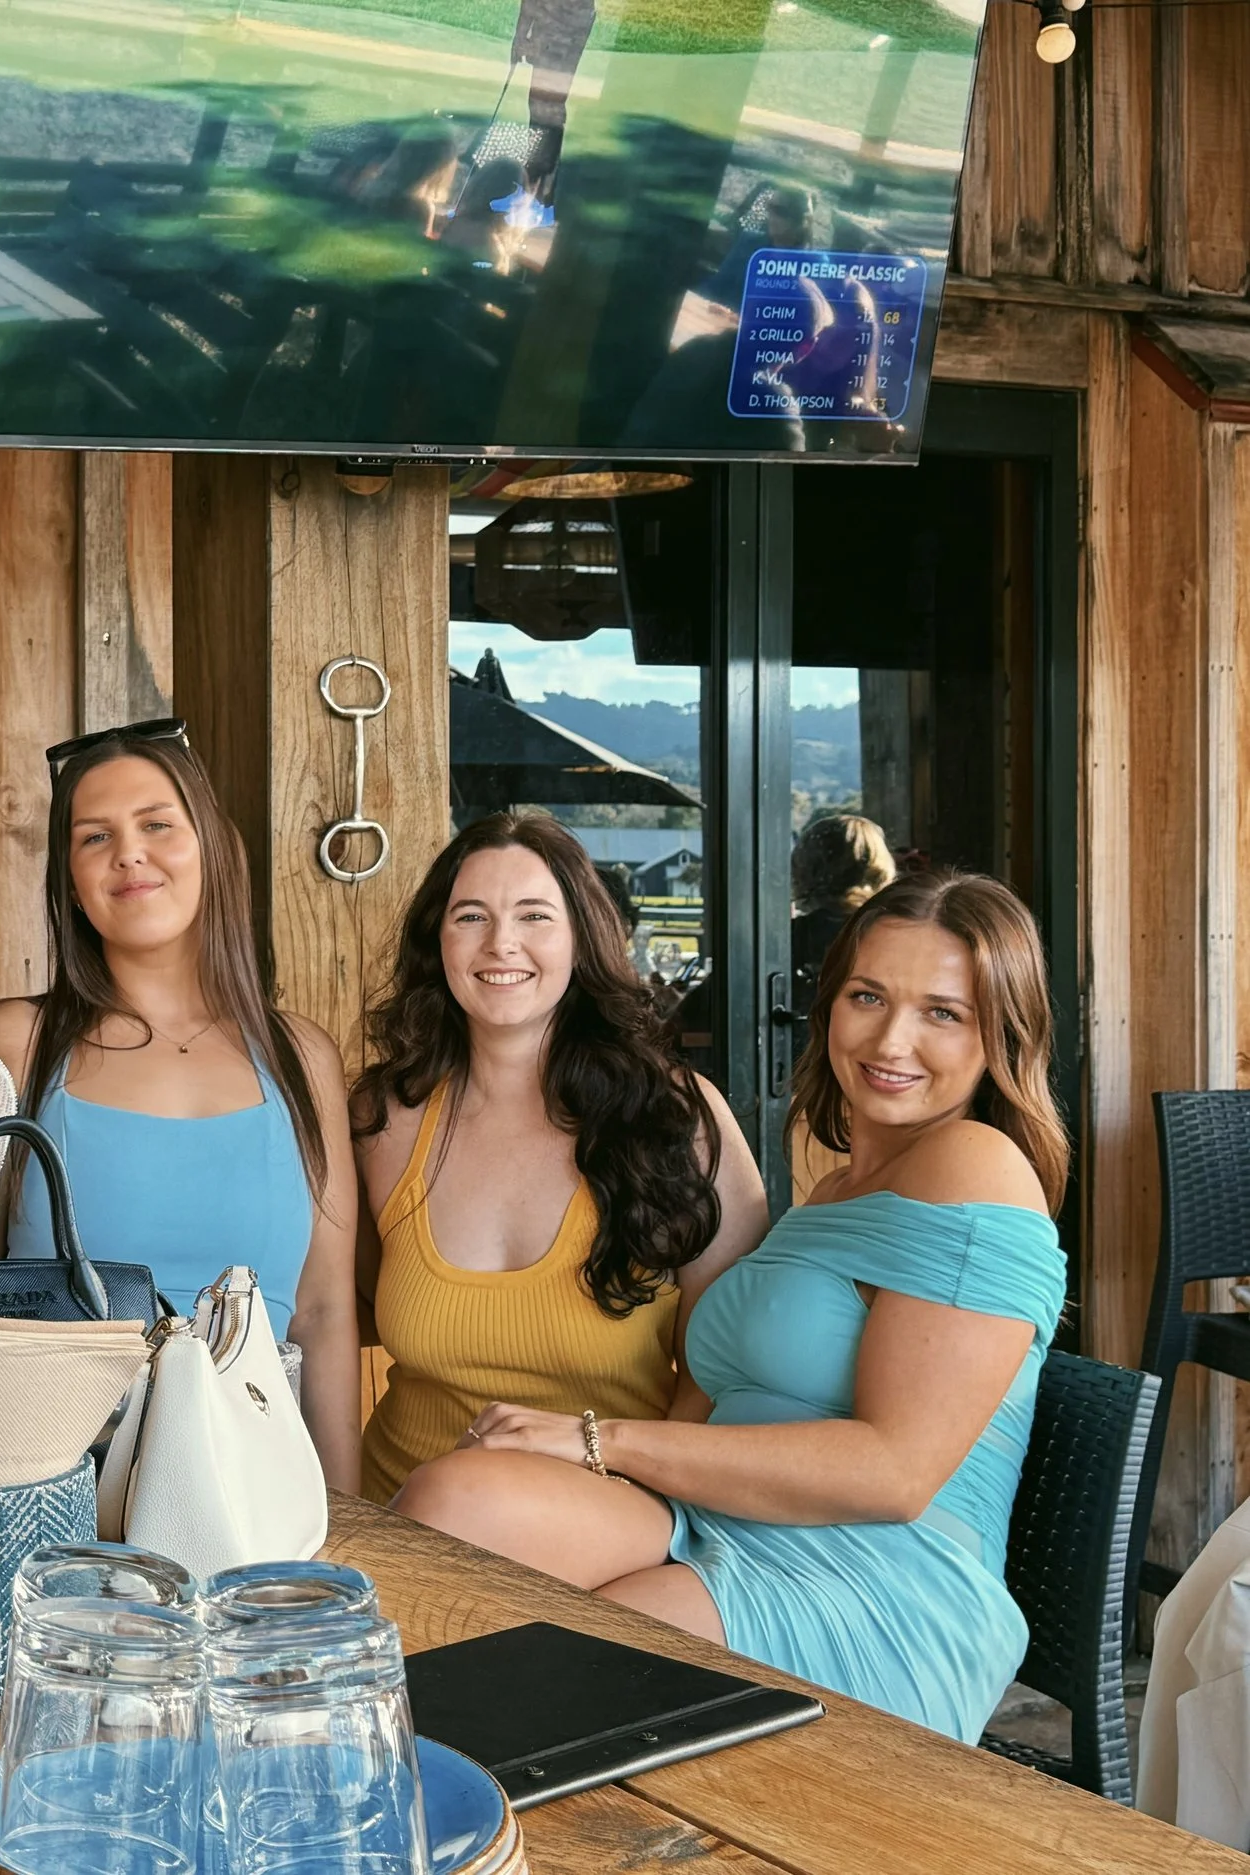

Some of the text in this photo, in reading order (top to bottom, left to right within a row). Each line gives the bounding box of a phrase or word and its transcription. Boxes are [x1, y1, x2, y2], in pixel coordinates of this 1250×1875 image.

[756, 260, 907, 282] JOHN DEERE CLASSIC
[755, 278, 798, 290] ROUND 2
[755, 307, 760, 318] 1
[762, 305, 796, 319] GHIM
[883, 311, 900, 325] 68
[749, 328, 895, 346] 2 GRILLO -11 14
[755, 350, 892, 368] HOMA -11 14
[848, 376, 864, 389] -11
[877, 376, 888, 389] 12
[748, 394, 761, 407] D.
[764, 394, 835, 408] THOMPSON
